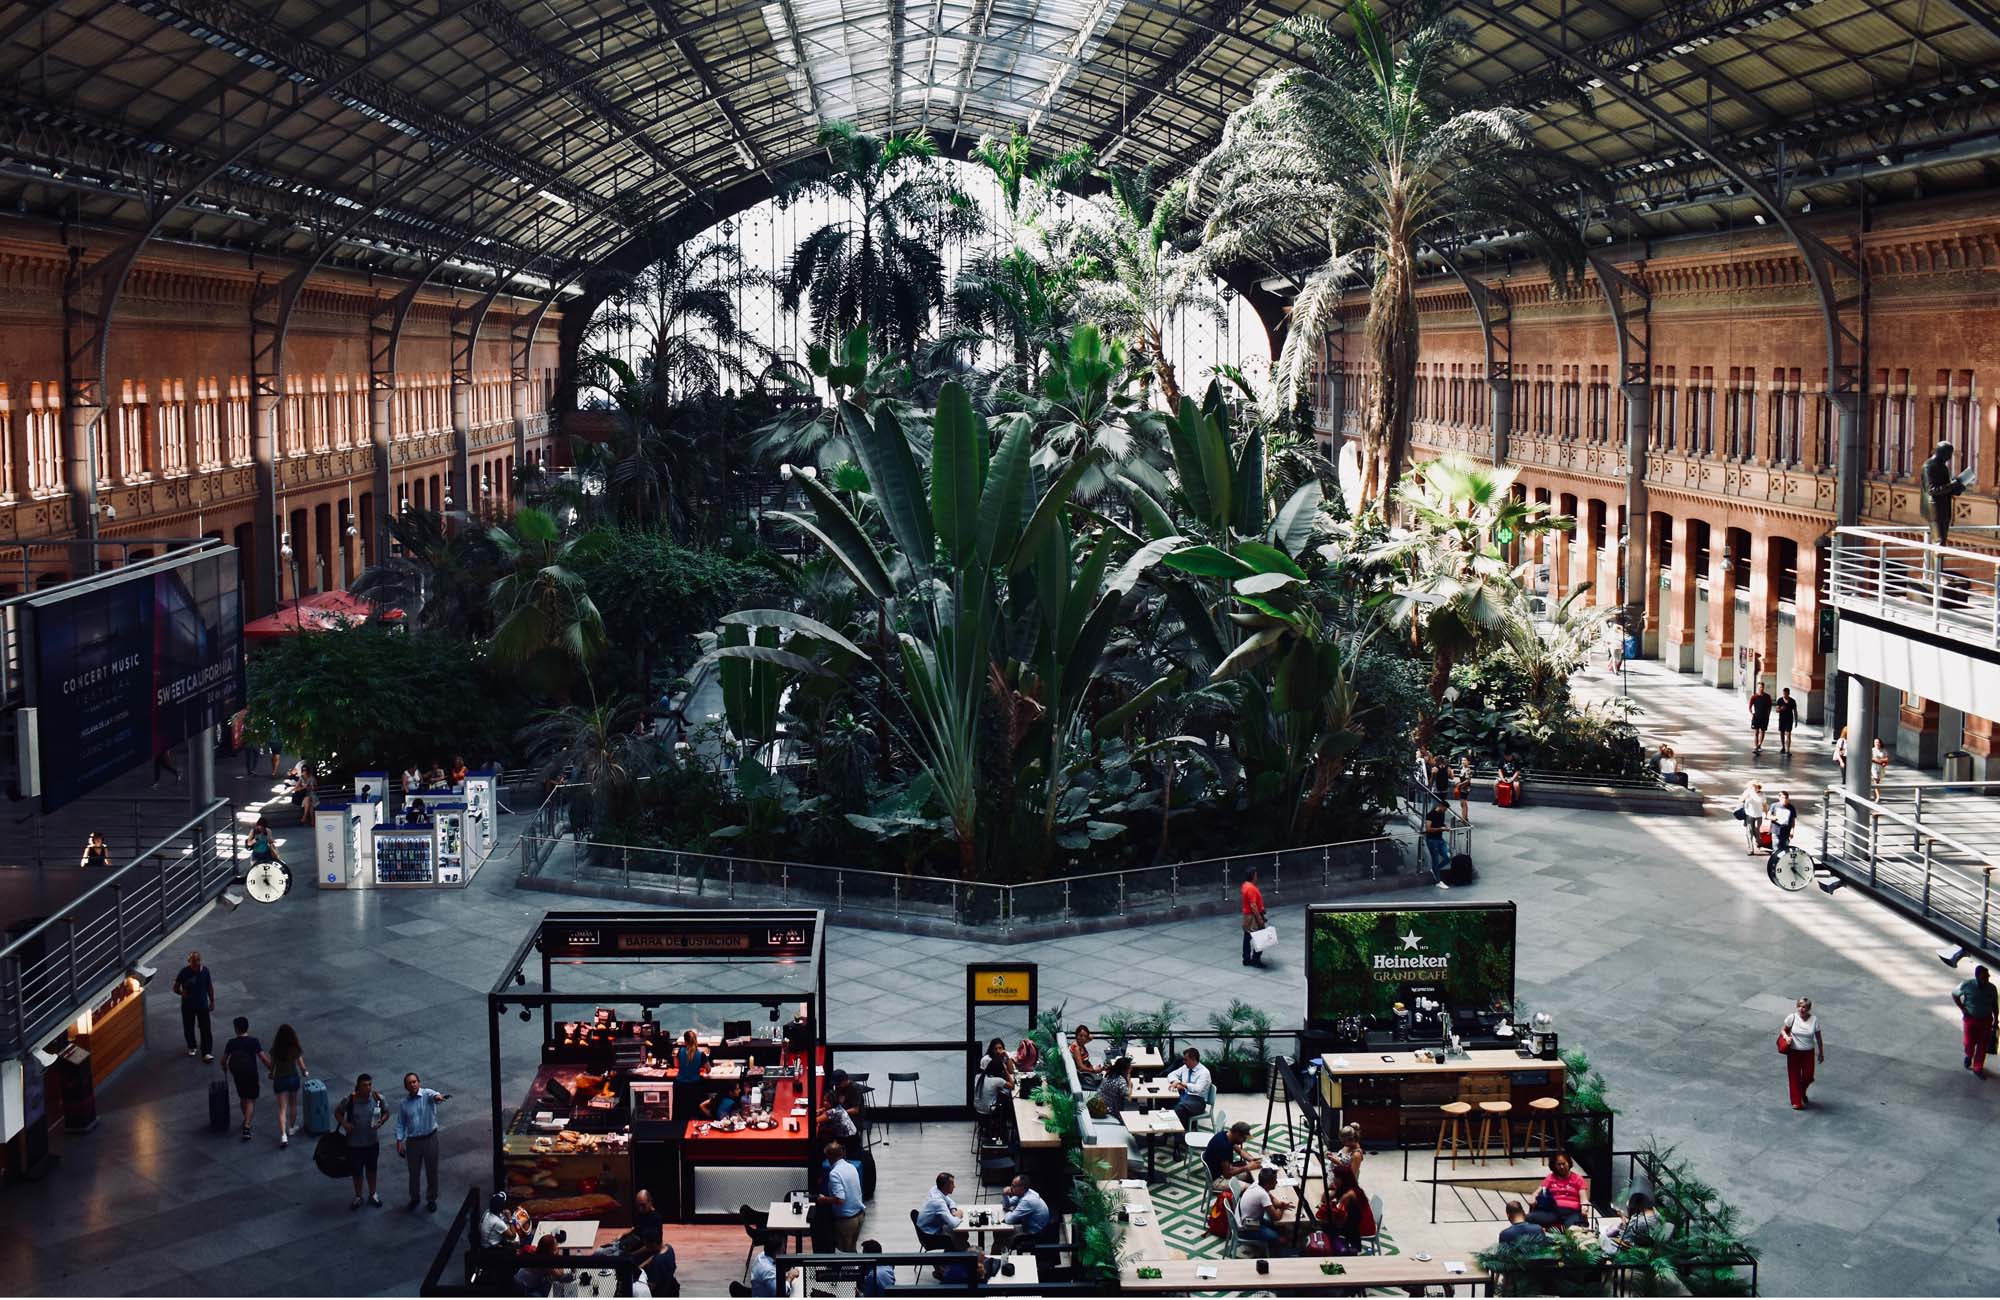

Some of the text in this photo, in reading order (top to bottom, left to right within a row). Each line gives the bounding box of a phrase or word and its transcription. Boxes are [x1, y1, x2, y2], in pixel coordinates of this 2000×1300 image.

[63, 653, 140, 695] CONCERT MUSIC
[157, 678, 186, 706] SWEET
[186, 657, 233, 692] CALIFORNIA
[327, 842, 335, 863] Apple
[625, 935, 663, 946] BARRA
[1373, 954, 1448, 969] Heineken
[1373, 969, 1448, 982] GRAND CAFÉ
[987, 986, 1018, 994] tiendas
